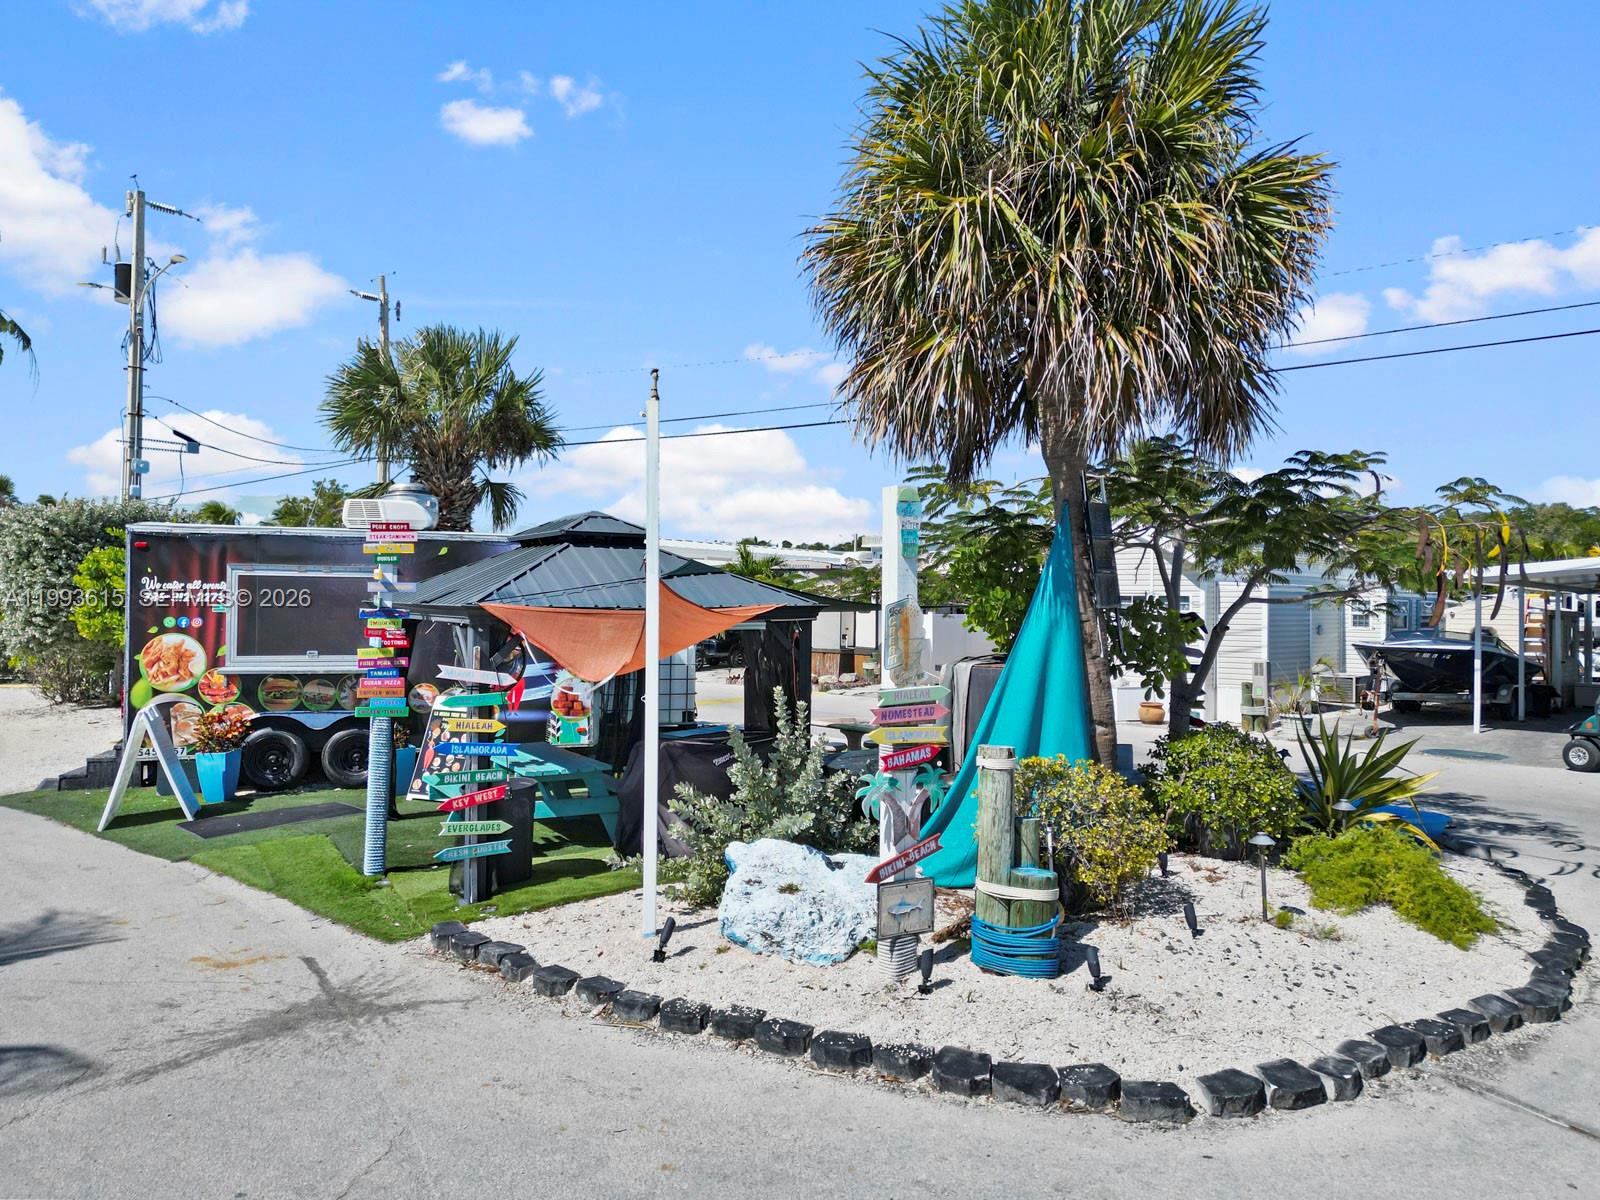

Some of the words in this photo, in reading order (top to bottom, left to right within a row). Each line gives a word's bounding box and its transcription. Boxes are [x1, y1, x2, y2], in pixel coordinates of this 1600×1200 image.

[141, 575, 161, 590] We
[187, 579, 202, 590] all
[881, 706, 935, 720] HOMESTEAD
[455, 721, 493, 730] HIALEAH
[451, 744, 508, 755] ISLAMORADA
[887, 747, 931, 768] BAHAMAS
[444, 773, 471, 783] BIKINI
[475, 771, 503, 781] BEACH
[452, 797, 470, 809] KEY
[474, 789, 498, 802] WEST
[447, 823, 502, 833] EVERGLADES
